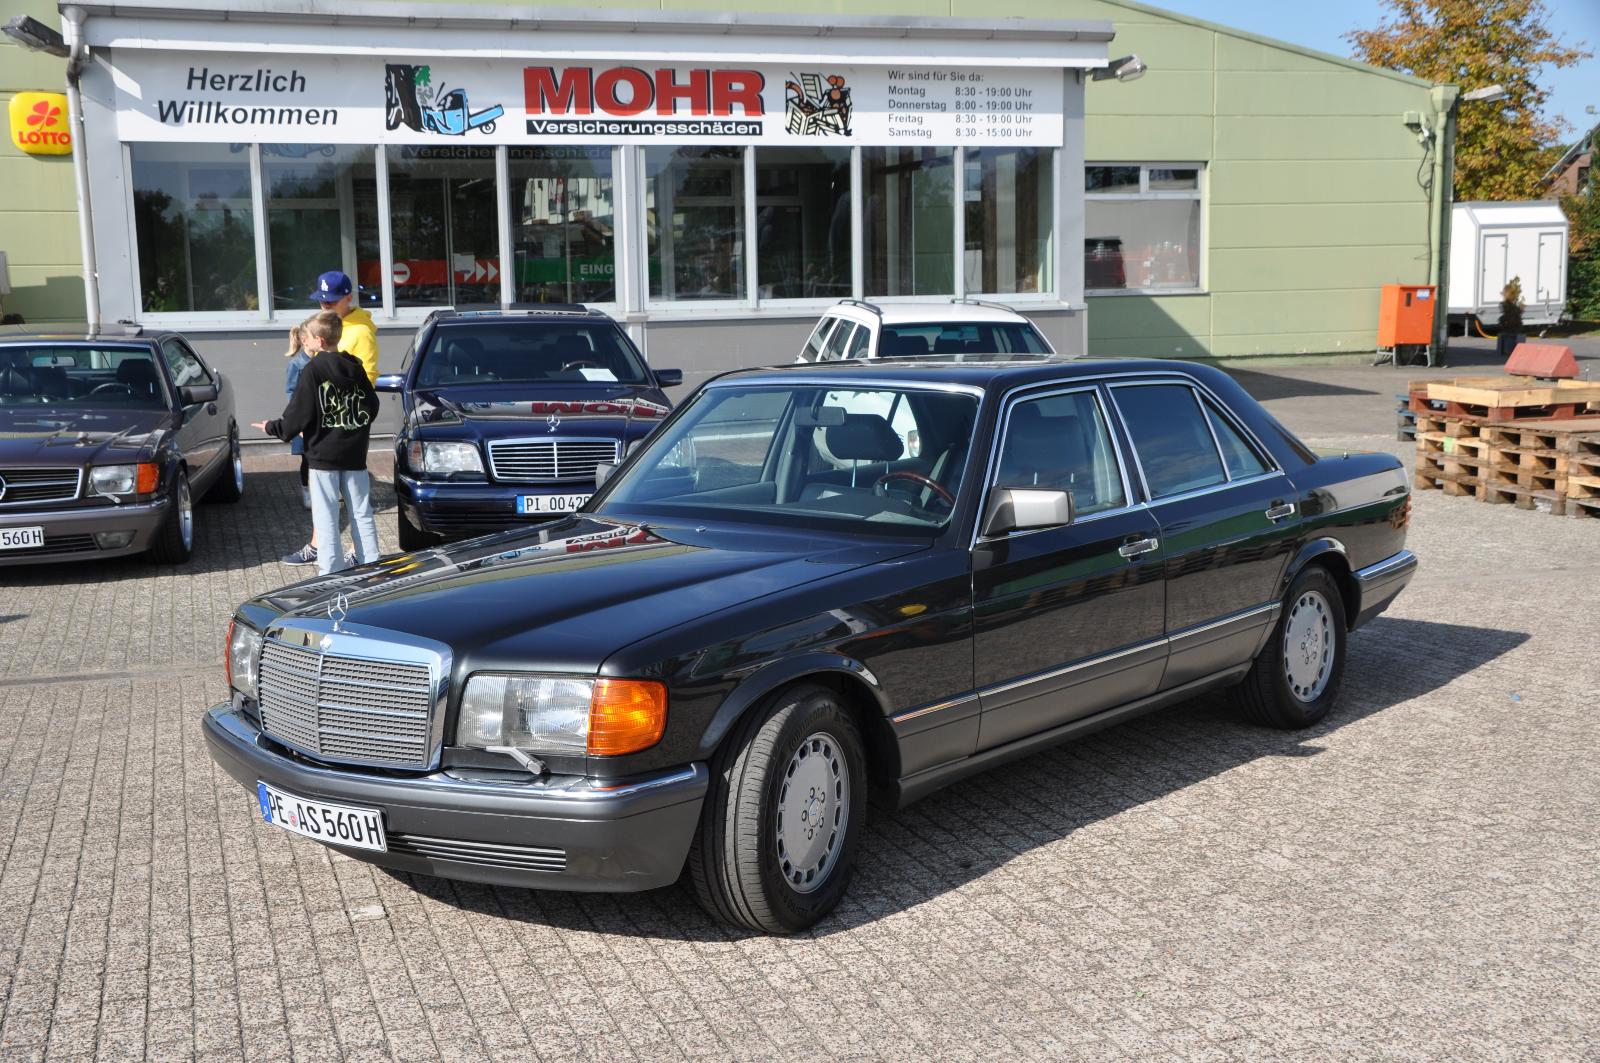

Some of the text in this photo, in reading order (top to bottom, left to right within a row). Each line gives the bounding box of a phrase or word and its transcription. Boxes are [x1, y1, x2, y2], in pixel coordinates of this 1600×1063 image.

[187, 67, 306, 92] Herzlich
[888, 70, 984, 82] Wir sind für Sie da:
[523, 66, 765, 116] MOHR
[888, 86, 926, 98] Montag
[955, 87, 976, 97] 8:30
[985, 87, 1012, 97] 19:00
[1014, 87, 1032, 97] Uhr
[158, 100, 338, 125] Willkommen
[888, 99, 947, 112] Donnerstag
[955, 101, 976, 111] 8:00
[985, 101, 1012, 111] 19:00
[1014, 101, 1032, 111] Uhr
[888, 114, 923, 125] Freitag
[955, 114, 976, 124] 8:30
[985, 114, 1012, 124] 19:00
[1014, 114, 1032, 124] Uhr
[533, 120, 760, 135] Versicherungsschäden
[888, 128, 932, 139] Samstag
[955, 128, 976, 137] 8:30
[985, 128, 1012, 137] 15:00
[1014, 128, 1032, 137] Uhr
[18, 131, 72, 145] LOTTO
[580, 263, 614, 275] EING
[526, 497, 541, 511] PI
[266, 791, 289, 824] PE
